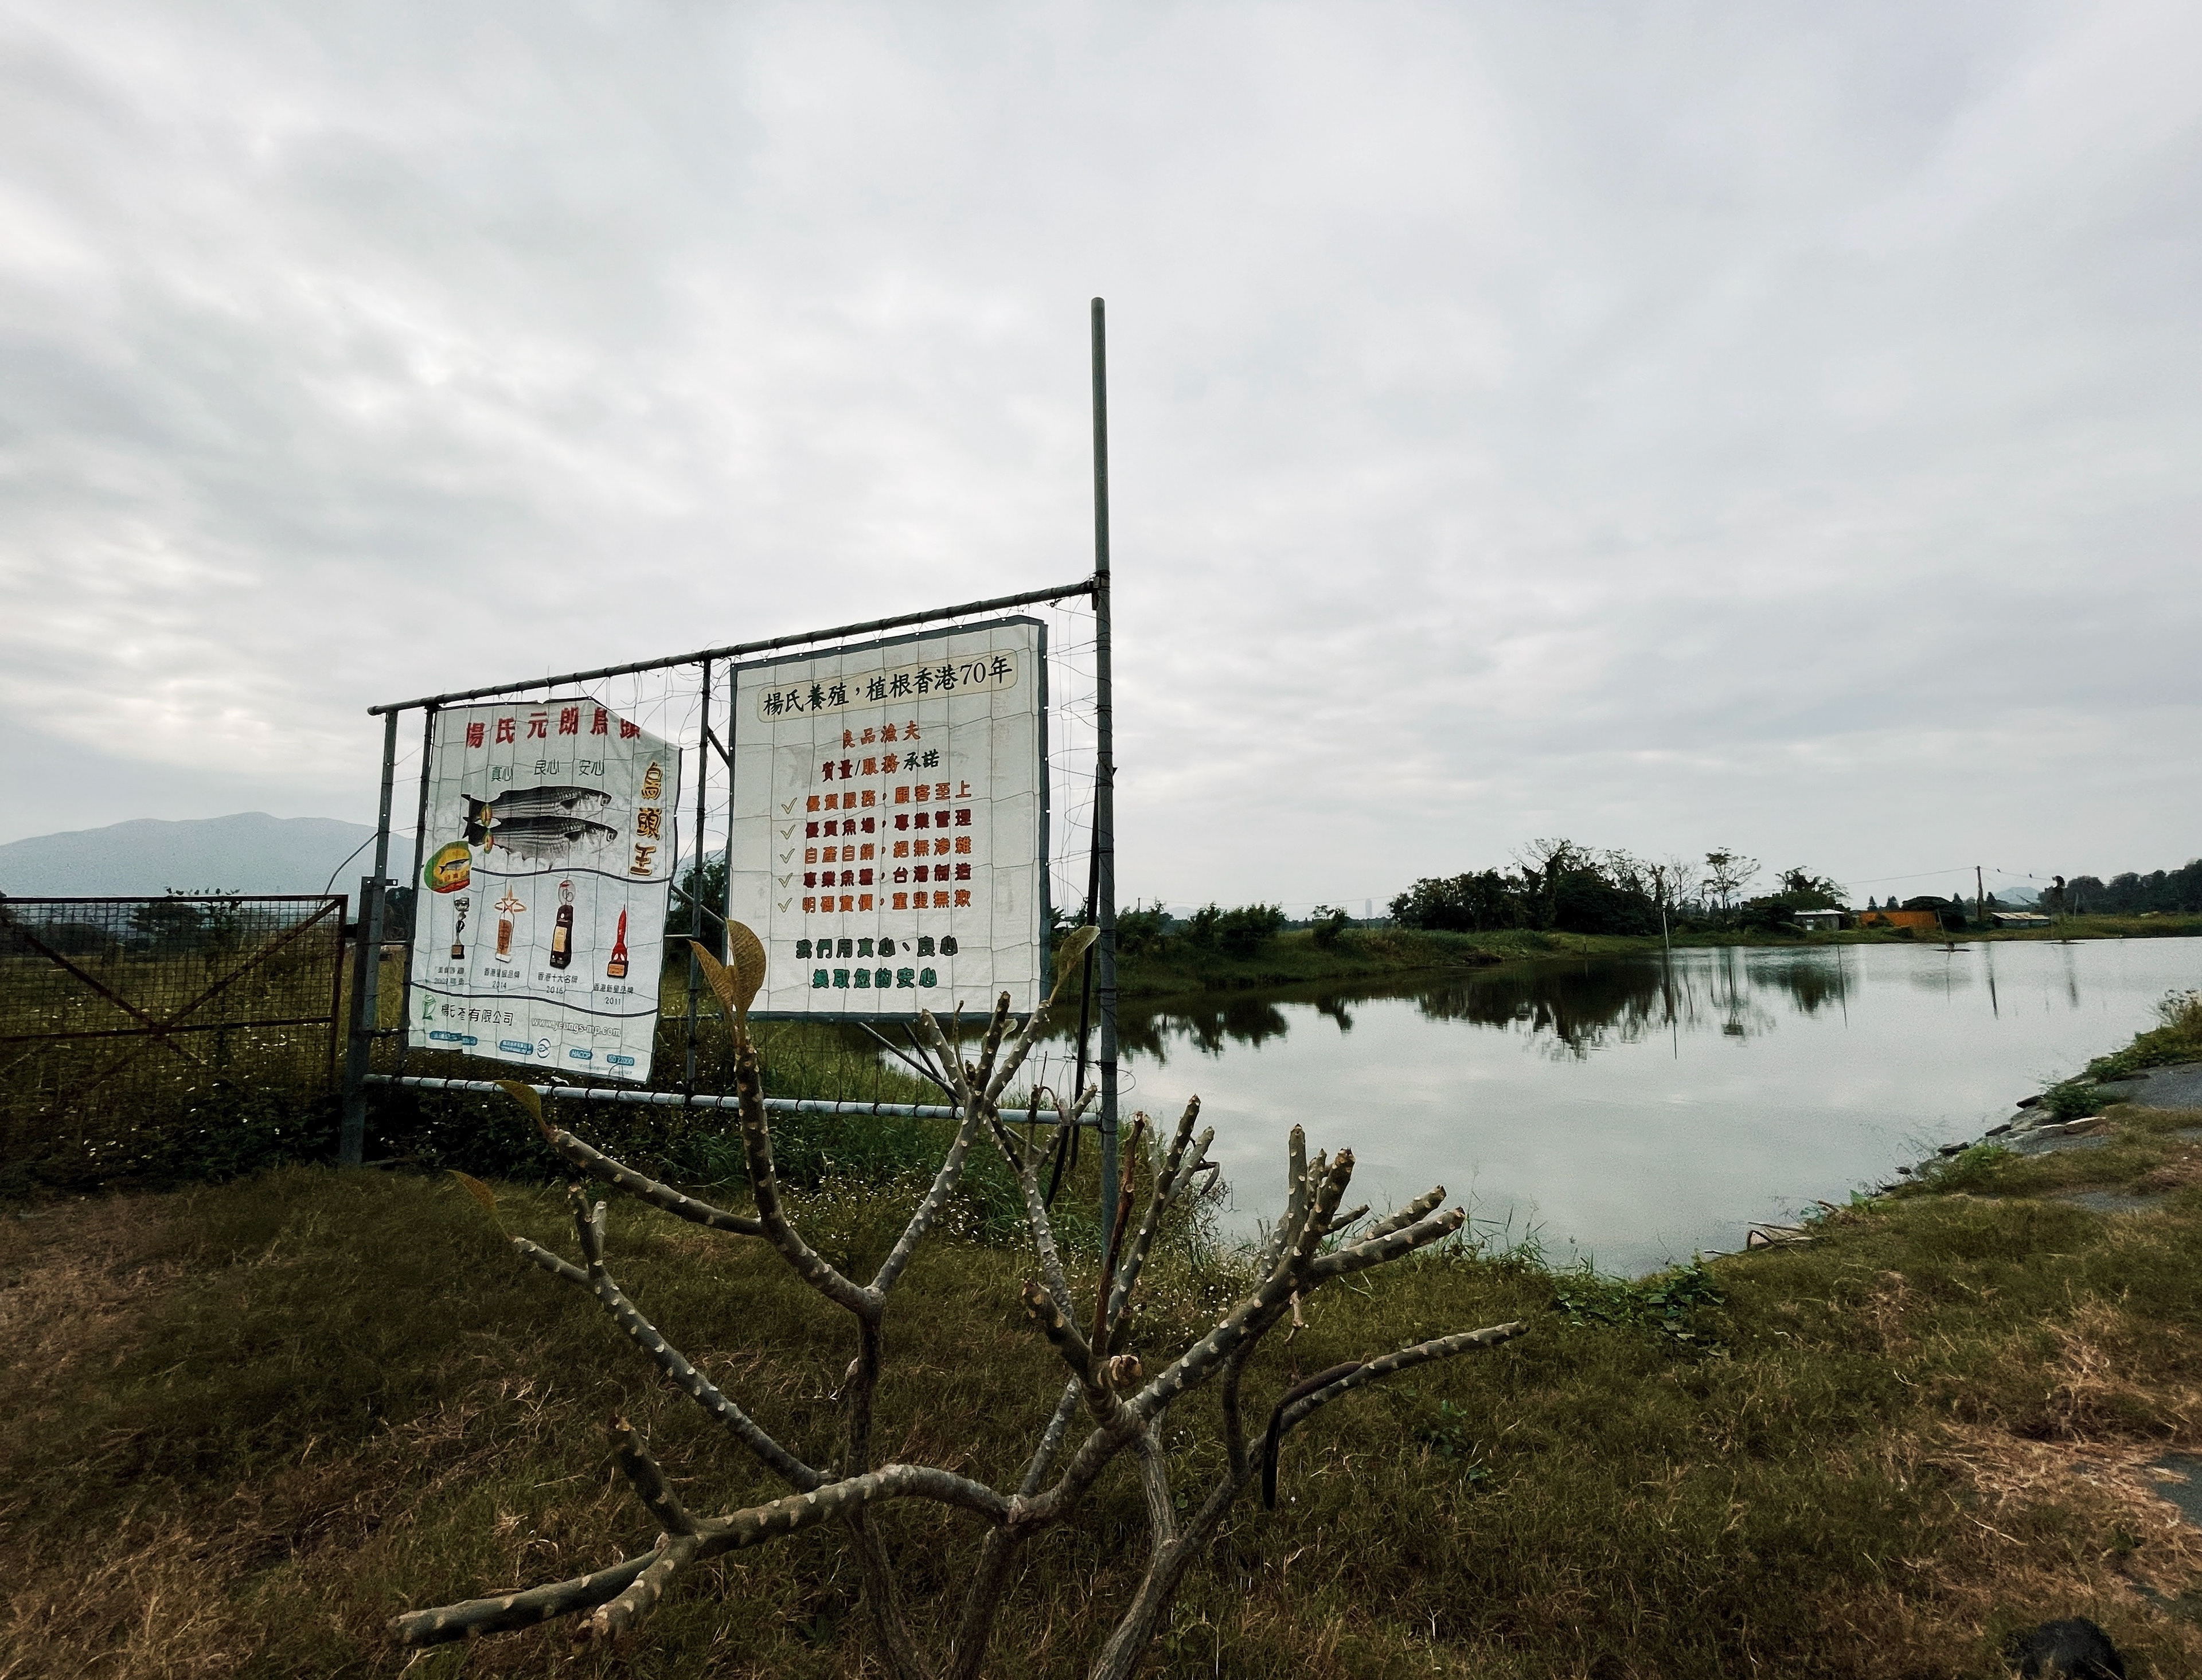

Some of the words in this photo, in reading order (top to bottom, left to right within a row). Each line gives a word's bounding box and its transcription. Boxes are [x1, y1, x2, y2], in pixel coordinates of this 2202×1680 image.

[842, 720, 921, 749] 良品漁夫
[490, 767, 513, 782] 真心
[579, 759, 605, 776] 安心
[821, 749, 940, 782] 質量/服務承諾
[630, 761, 663, 876] 烏頭王
[537, 972, 579, 983] 香港十大名牌
[605, 997, 621, 1005] 2011
[531, 1018, 621, 1037] www.yeungs-mp.com
[571, 1050, 591, 1059] HACCP
